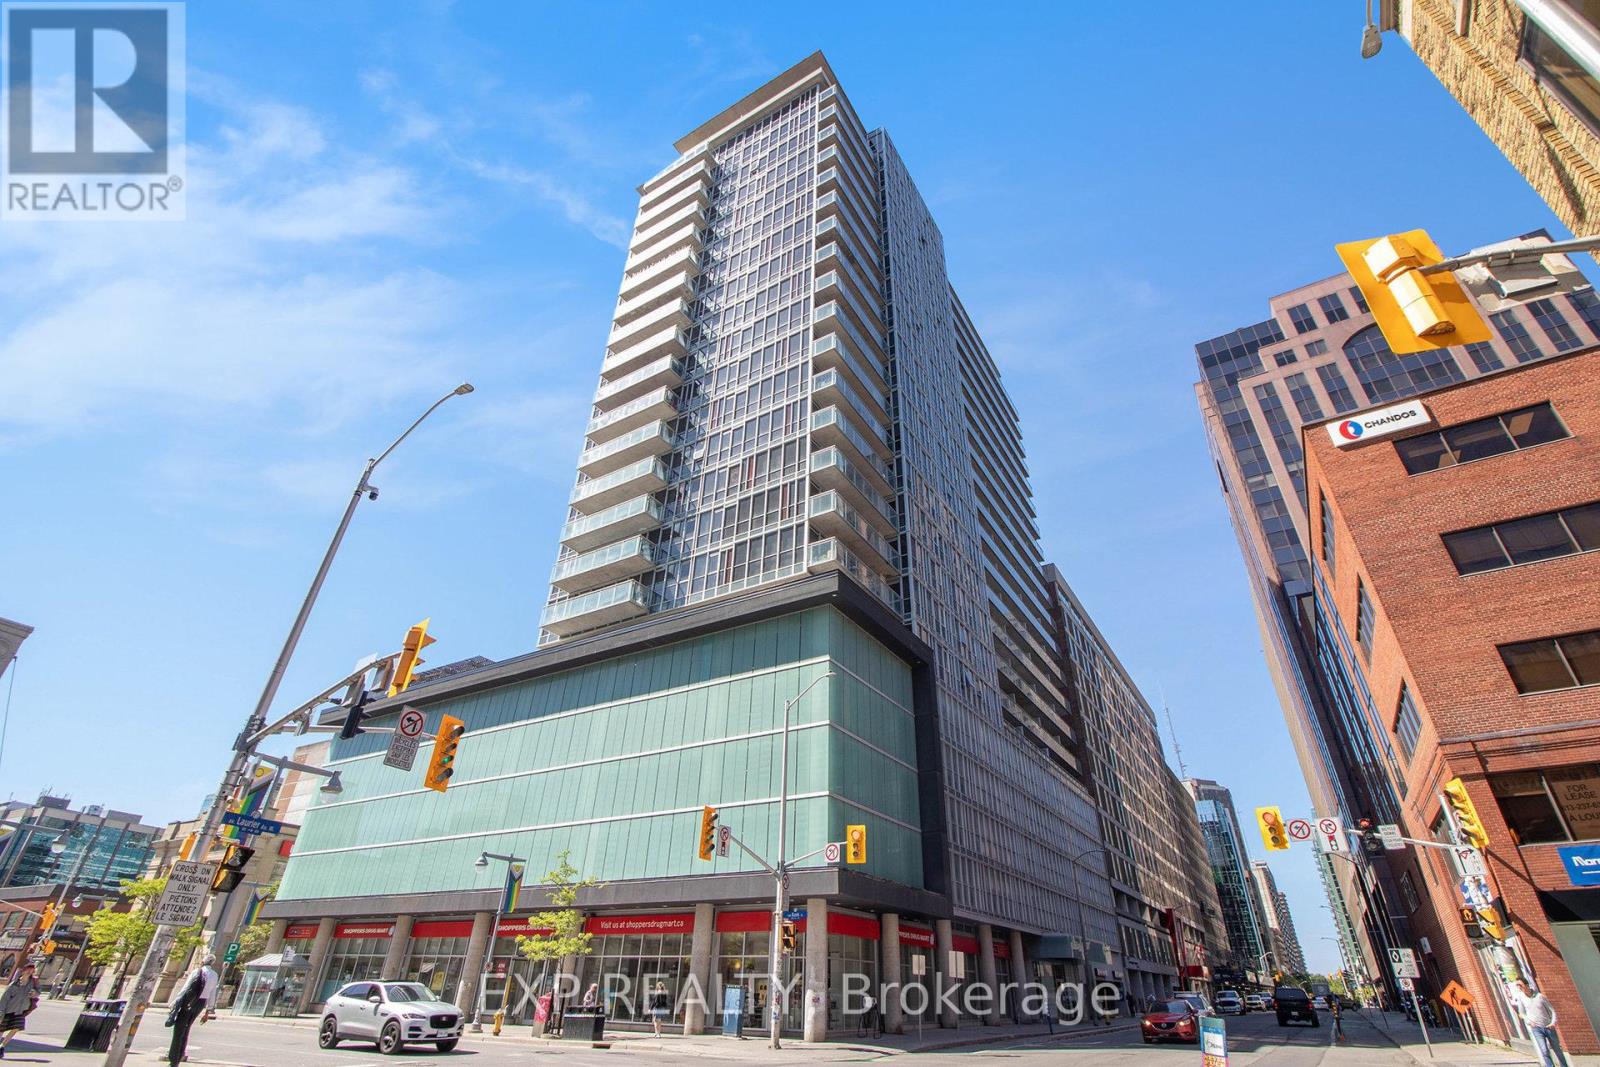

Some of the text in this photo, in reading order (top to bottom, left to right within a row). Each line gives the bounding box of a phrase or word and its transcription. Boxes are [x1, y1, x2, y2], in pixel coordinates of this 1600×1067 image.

[1364, 410, 1417, 429] CHANDOS
[1567, 784, 1587, 793] FOR
[1564, 791, 1598, 801] LEASE
[237, 817, 261, 829] Laurier
[175, 864, 212, 876] CROSS ON
[170, 874, 210, 885] WALK SIGNAL
[178, 883, 197, 892] ONLY
[160, 903, 197, 914] ATTENDEZ
[155, 912, 193, 923] LE SIGNAL
[600, 921, 612, 929] Visit
[626, 920, 684, 929] shoppersdrugmart.ca
[228, 944, 238, 954] P
